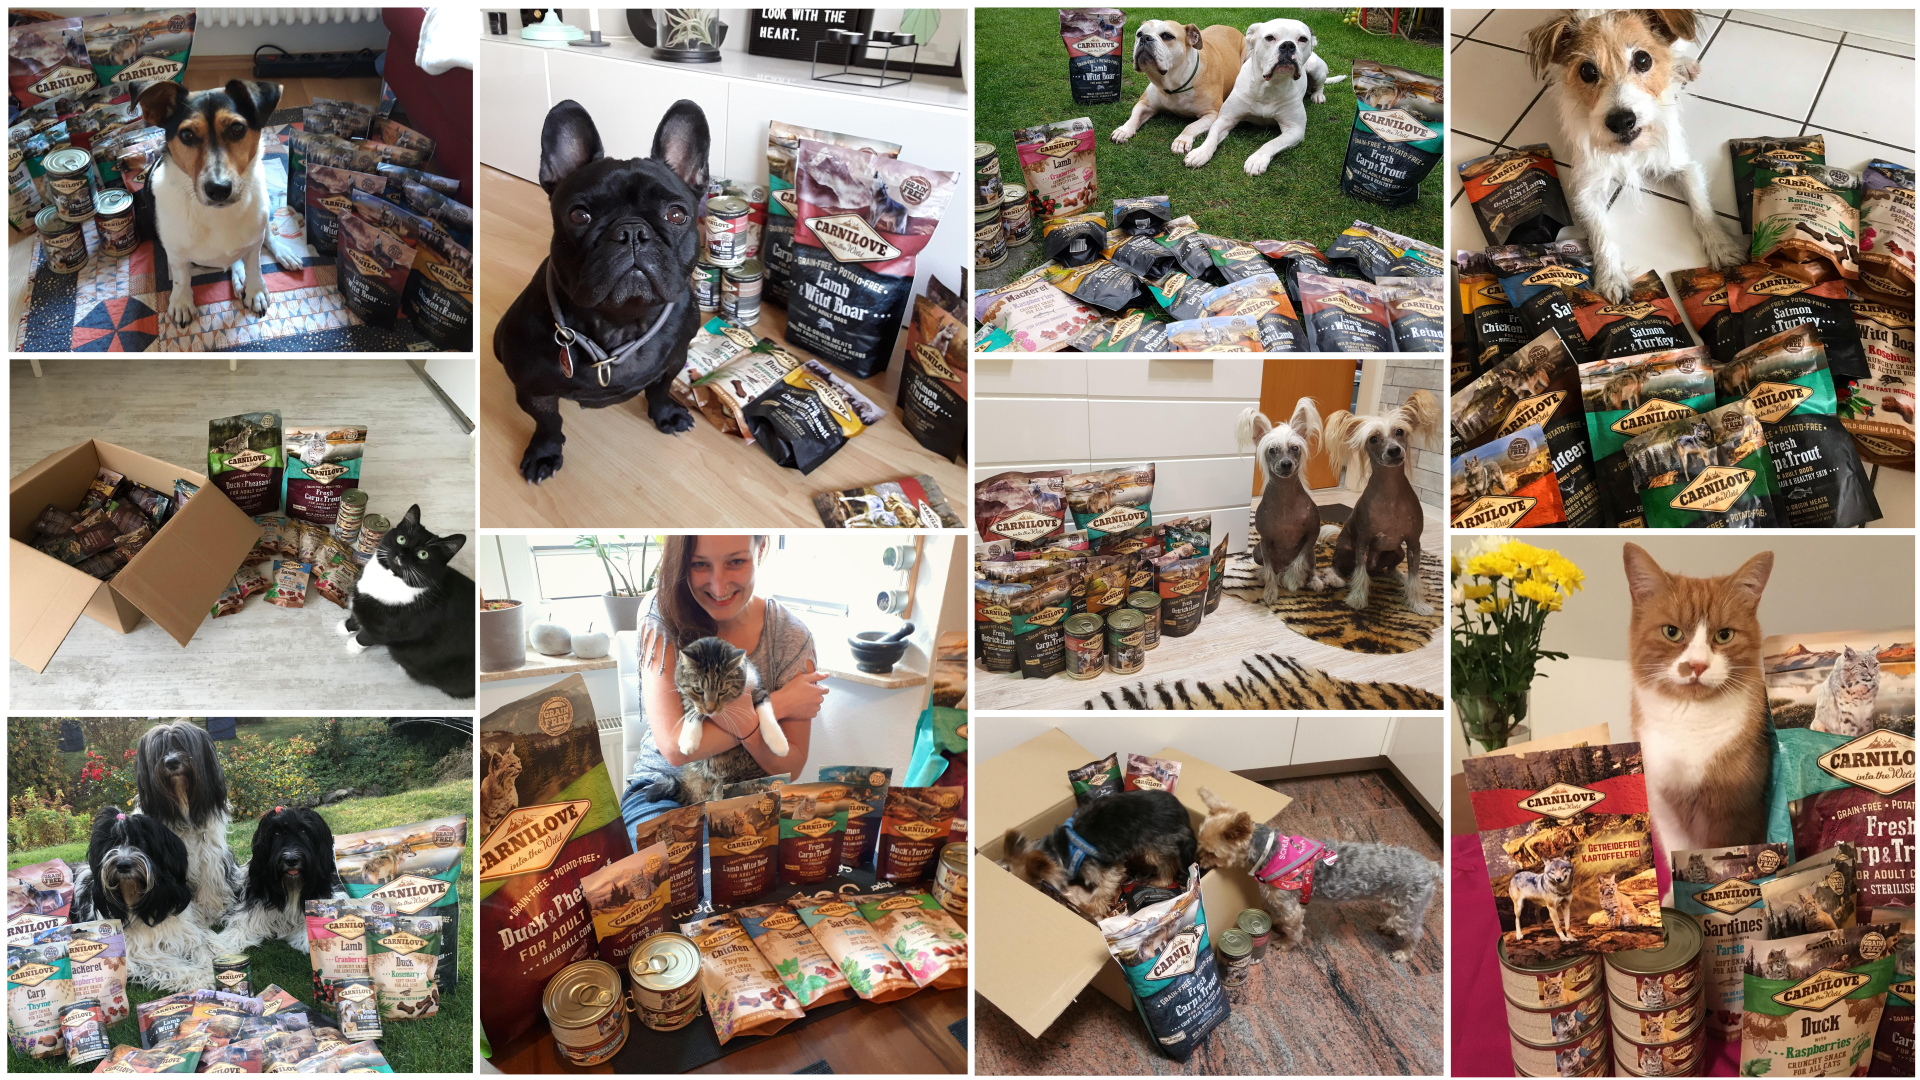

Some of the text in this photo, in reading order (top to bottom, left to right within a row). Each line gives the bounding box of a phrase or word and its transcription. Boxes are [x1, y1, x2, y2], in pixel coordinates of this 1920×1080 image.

[762, 8, 846, 24] LOOK WITH THE
[760, 26, 800, 41] HEART.
[1077, 42, 1114, 50] CARNILOVE
[119, 63, 178, 82] CARNILOVE
[1090, 64, 1107, 72] Lamb
[1362, 112, 1427, 137] CARNILOVE
[1040, 140, 1078, 153] CARNILOVE
[1371, 149, 1394, 164] Fresh
[1387, 144, 1421, 166] POTATO-FREE
[1054, 158, 1072, 168] Lamb
[1486, 158, 1535, 184] CARNILOVE
[902, 186, 924, 199] FREE
[905, 179, 929, 192] GRAIN
[1508, 182, 1528, 194] Fresh
[1788, 197, 1832, 212] Rosemary
[814, 219, 888, 256] CARNILOVE
[348, 250, 386, 277] CARNILOVE
[797, 256, 884, 294] GRAIN-FREE POTATO-FREE
[1530, 269, 1584, 282] CARNILOVE
[816, 270, 851, 297] Lamb
[1861, 270, 1907, 296] CARNILOVE
[432, 293, 450, 307] Fresh
[1006, 284, 1049, 302] Mackerel
[804, 282, 869, 321] Wild Boar
[1322, 297, 1368, 314] CARNILOVE
[1756, 297, 1827, 317] GRAIN-FREE POTATO-FREE
[1774, 306, 1812, 319] Salmon
[1110, 313, 1144, 342] CARNILOVE
[1335, 321, 1376, 337] Wild Boar
[1340, 316, 1362, 327] Lamb
[1482, 322, 1523, 334] Chicken
[1632, 326, 1665, 338] Salmon
[1635, 337, 1674, 351] Turkey
[1868, 344, 1911, 364] Rosehips
[914, 344, 954, 381] CARNILOVE
[807, 378, 849, 417] CARNILOVE
[1620, 408, 1692, 432] CARNILOVE
[1724, 421, 1742, 429] FREE
[1779, 423, 1823, 434] POTATO-FREE
[1843, 423, 1900, 434] WILD-ORIGIN MEATS
[1510, 447, 1527, 455] FREE
[1769, 438, 1798, 453] Fresh
[228, 454, 267, 465] CARNILOVE
[1679, 470, 1750, 506] CARNILOVE
[1723, 489, 1740, 502] Wild
[996, 520, 1058, 532] CARNILOVE
[1093, 511, 1146, 528] CARNILOVE
[543, 705, 569, 720] GRAIN
[544, 714, 569, 728] FREE
[1856, 771, 1874, 781] into
[1875, 770, 1890, 779] the
[1527, 792, 1596, 808] CARNILOVE
[1837, 802, 1883, 820] GRAIN-FREE
[797, 822, 834, 831] CARNILOVE
[727, 837, 765, 850] CARNILOVE
[890, 846, 935, 856] Duck Turkey
[1588, 840, 1640, 853] GETREIDEFREI
[510, 833, 564, 872] into the Wild
[1581, 850, 1642, 863] KARTOFFELFREI
[1874, 870, 1905, 879] ADULT
[511, 853, 596, 915] GRAIN-FREE POTATO-FREE
[1701, 887, 1762, 901] CARNILOVE
[615, 898, 657, 926] CARNILOVE
[817, 904, 857, 915] CARNILOVE
[878, 899, 920, 910] CARNILOVE
[763, 915, 801, 928] CARNILOVE
[830, 917, 866, 929] Sardines
[1704, 919, 1763, 937] Sardines
[498, 912, 549, 950] Duck
[519, 910, 585, 962] FOR ADULT
[630, 926, 649, 941] Fresh
[703, 928, 745, 946] CARNILOVE
[341, 940, 362, 951] Lamb
[383, 938, 424, 946] CARNILOVE
[1863, 939, 1883, 947] GRAIN
[542, 938, 578, 965] HAIRBALL
[712, 944, 749, 959] Chicken
[1716, 944, 1744, 956] Parsle
[396, 957, 414, 967] Duck
[723, 956, 749, 966] Thyme
[10, 966, 54, 981] CARNILOVE
[27, 989, 46, 1000] Carp
[1160, 979, 1191, 1006] GRAIN-FREE
[1187, 978, 1206, 997] Fresh
[1784, 975, 1859, 1001] CARNILOVE
[1824, 990, 1842, 1000] Wild
[27, 1000, 51, 1011] Thyme
[62, 1011, 92, 1024] CARNILOVE
[1801, 1015, 1841, 1038] Duck
[1786, 1038, 1851, 1059] Raspberries
[1788, 1051, 1847, 1070] CRUNCHY SNACK
[1793, 1060, 1841, 1076] FOR ALL CATS
